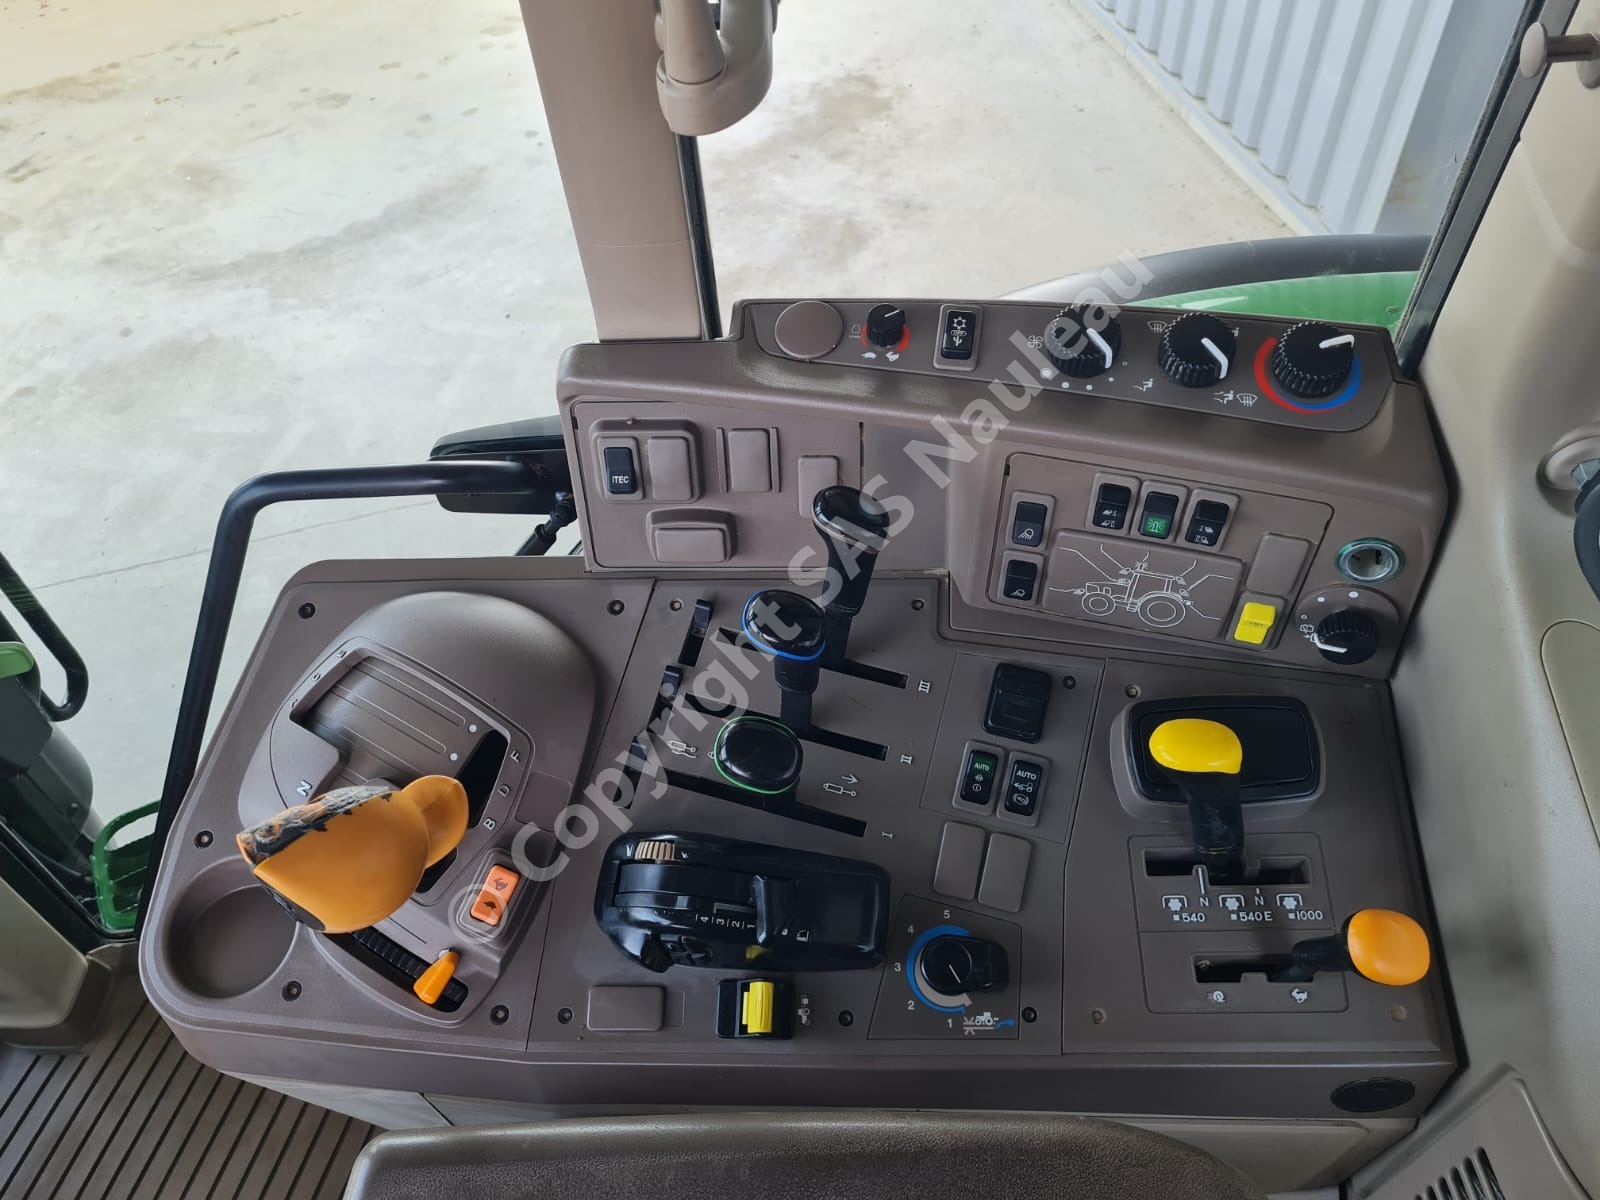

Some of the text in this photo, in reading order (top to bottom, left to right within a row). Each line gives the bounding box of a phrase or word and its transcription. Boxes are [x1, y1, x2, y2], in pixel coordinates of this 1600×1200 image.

[510, 750, 520, 762] F
[974, 762, 990, 771] AUTO
[1016, 769, 1037, 780] AUTO
[296, 779, 313, 798] N
[497, 785, 510, 797] D
[483, 818, 496, 830] B
[1200, 896, 1264, 907] N N
[943, 909, 951, 919] 5
[1182, 912, 1206, 922] 540
[1296, 910, 1323, 920] 1000
[701, 915, 709, 923] 4
[716, 918, 725, 926] 3
[731, 920, 740, 928] 2
[907, 925, 914, 934] 4
[894, 962, 902, 972] 3
[907, 1000, 915, 1010] 2
[947, 1018, 953, 1028] 1
